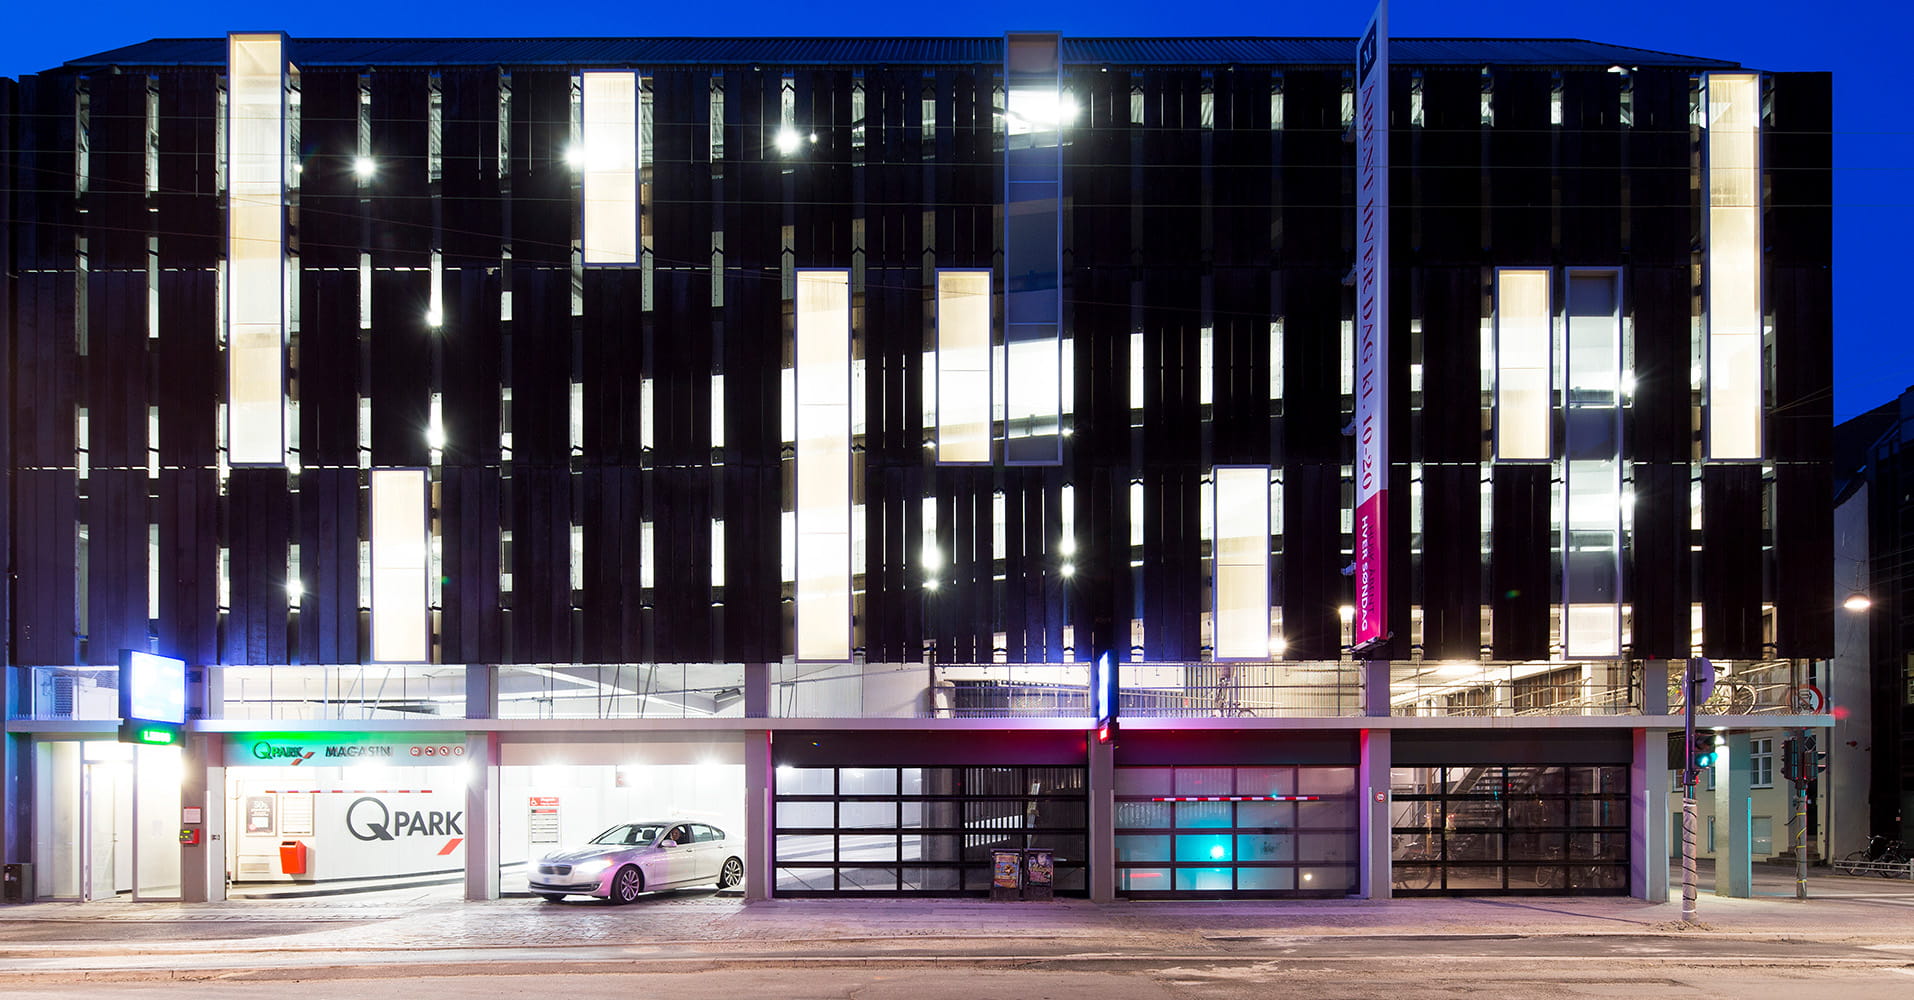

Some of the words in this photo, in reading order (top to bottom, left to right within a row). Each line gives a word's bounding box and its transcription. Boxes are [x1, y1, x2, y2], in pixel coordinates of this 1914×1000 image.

[1363, 197, 1374, 294] HVER
[1363, 296, 1374, 366] DAG
[1362, 413, 1373, 489] 10-20
[1361, 515, 1369, 560] HVER
[1361, 563, 1369, 632] SØNDAG
[325, 745, 392, 758] MAGASIN
